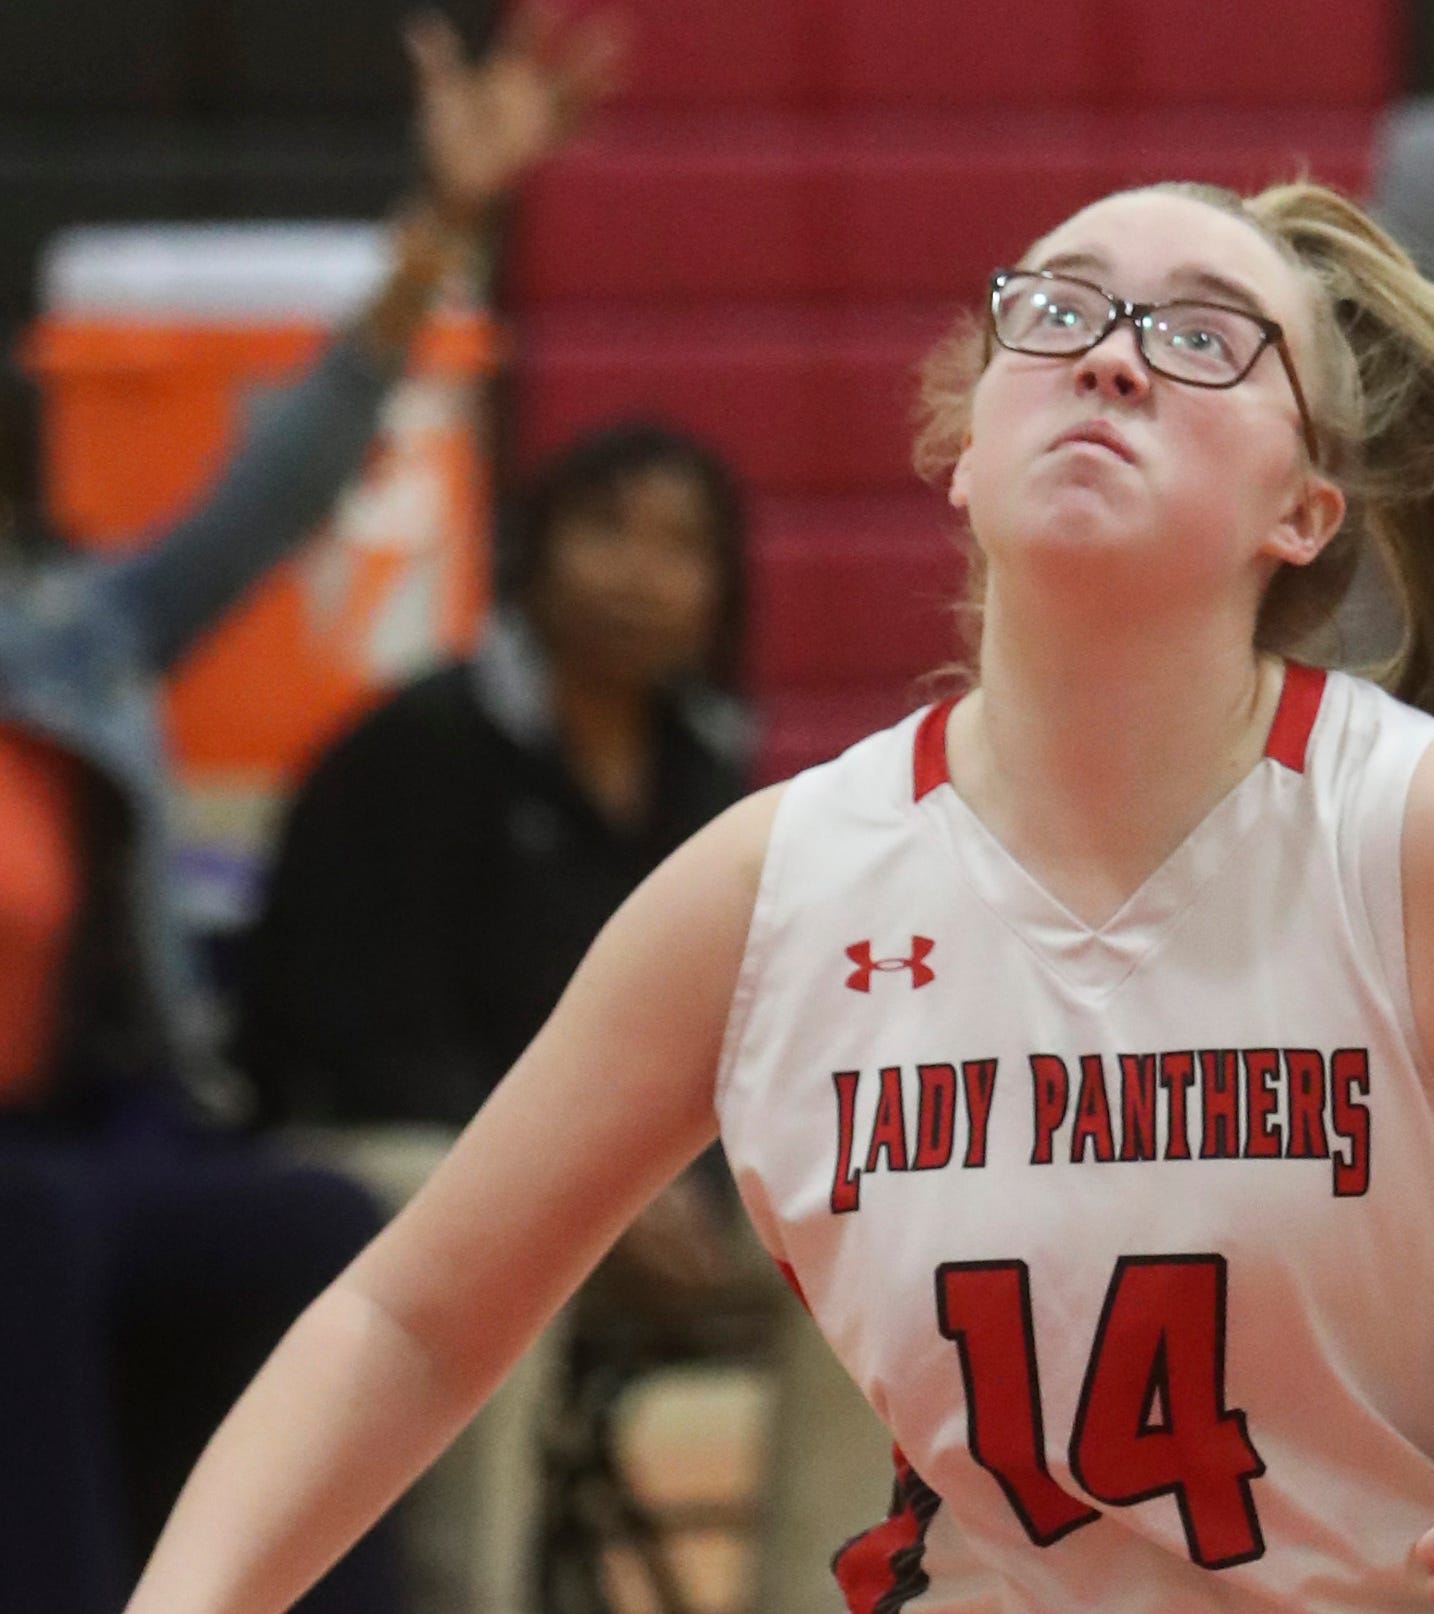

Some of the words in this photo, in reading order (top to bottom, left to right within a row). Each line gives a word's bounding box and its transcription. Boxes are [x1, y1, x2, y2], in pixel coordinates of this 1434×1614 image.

[831, 1057, 999, 1213] LADY
[1028, 1047, 1371, 1198] PANTHERS
[935, 1253, 1267, 1570] 14
